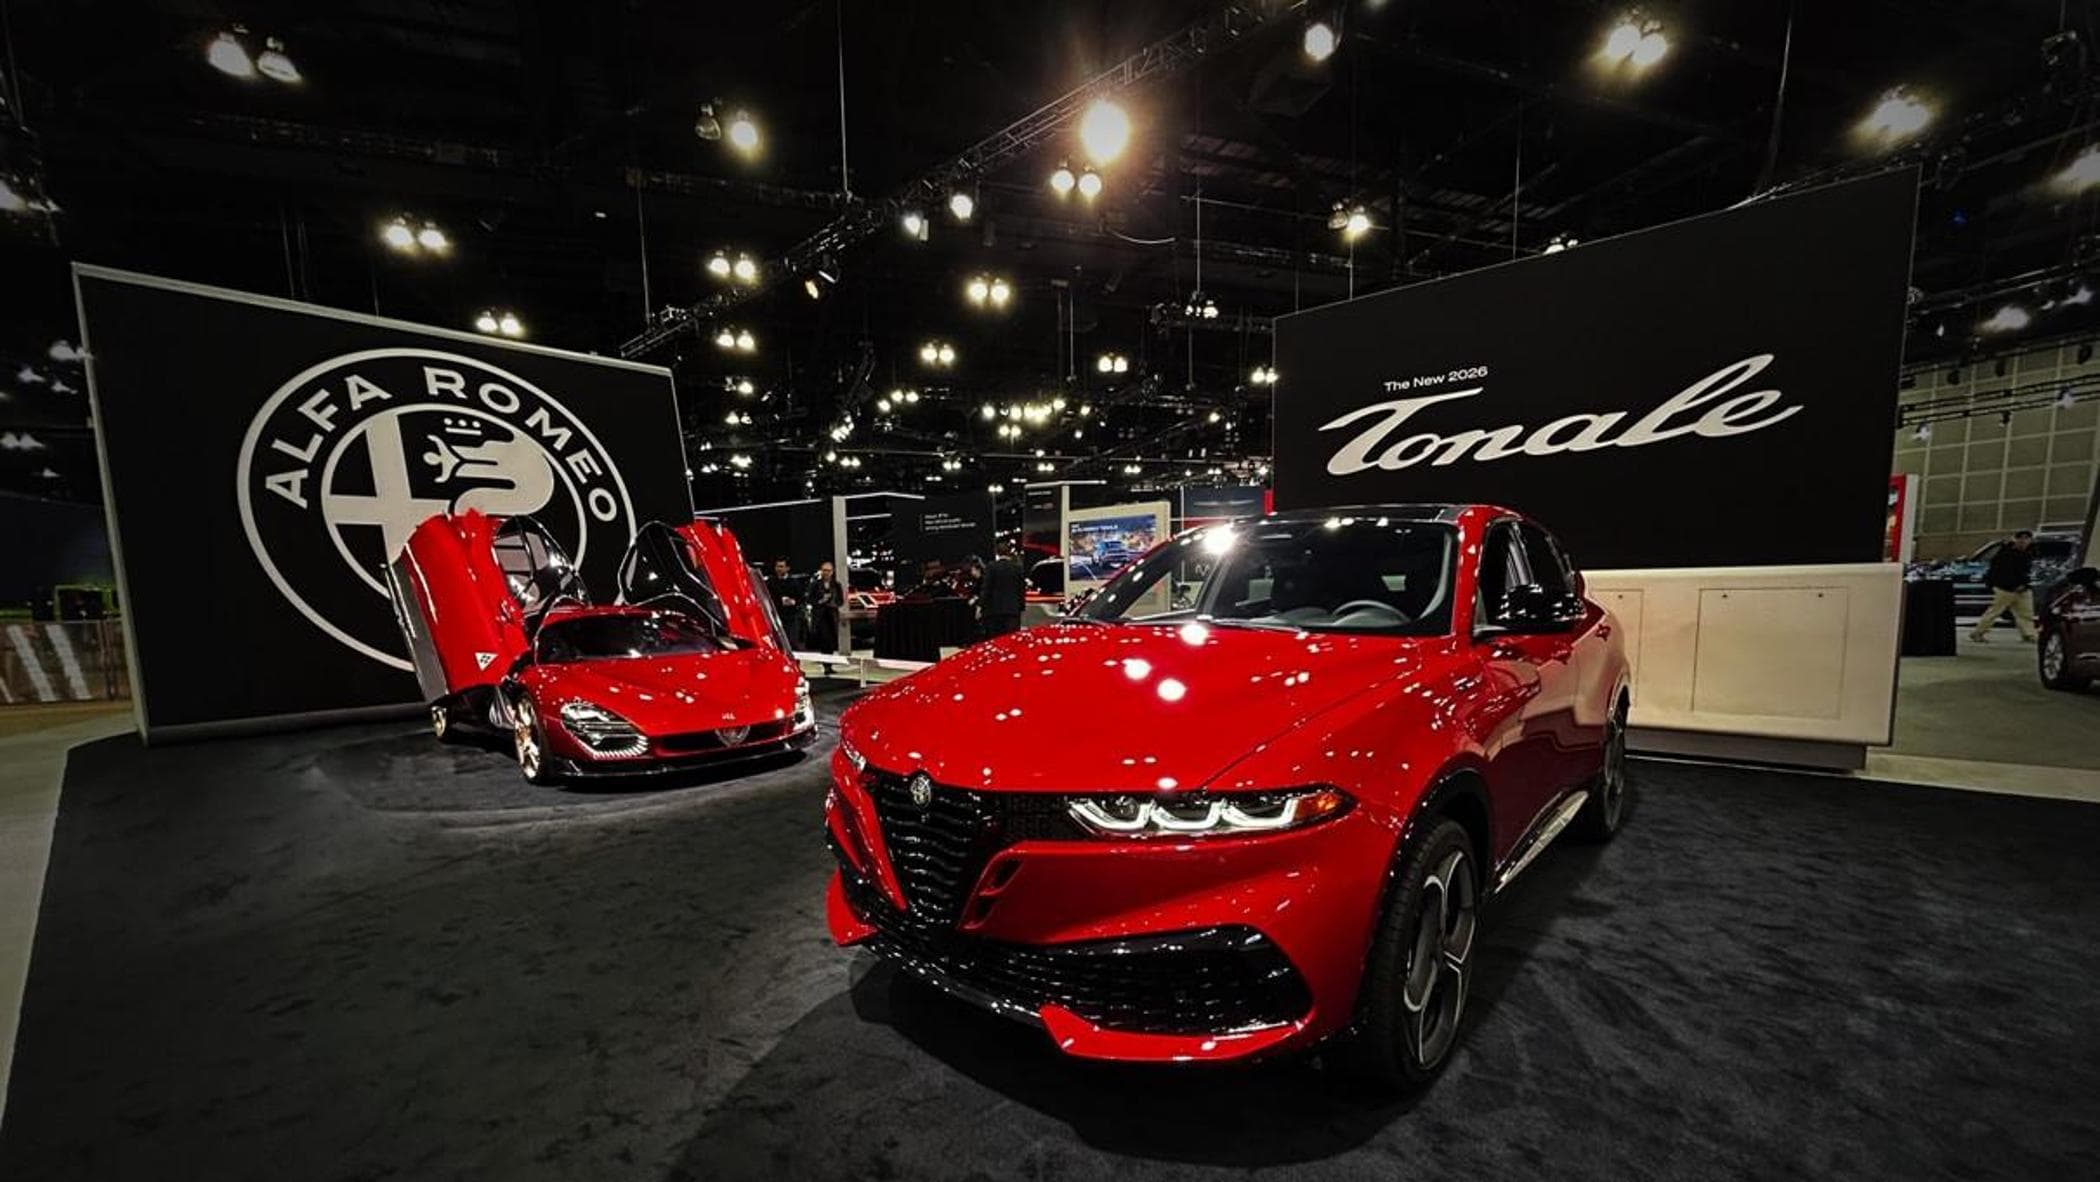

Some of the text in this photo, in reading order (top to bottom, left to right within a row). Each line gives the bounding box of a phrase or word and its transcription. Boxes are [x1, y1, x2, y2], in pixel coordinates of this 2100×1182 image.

[1318, 353, 1805, 476] Tonale
[1384, 365, 1489, 393] The New 2026
[265, 366, 619, 523] ALFA ROMEO
